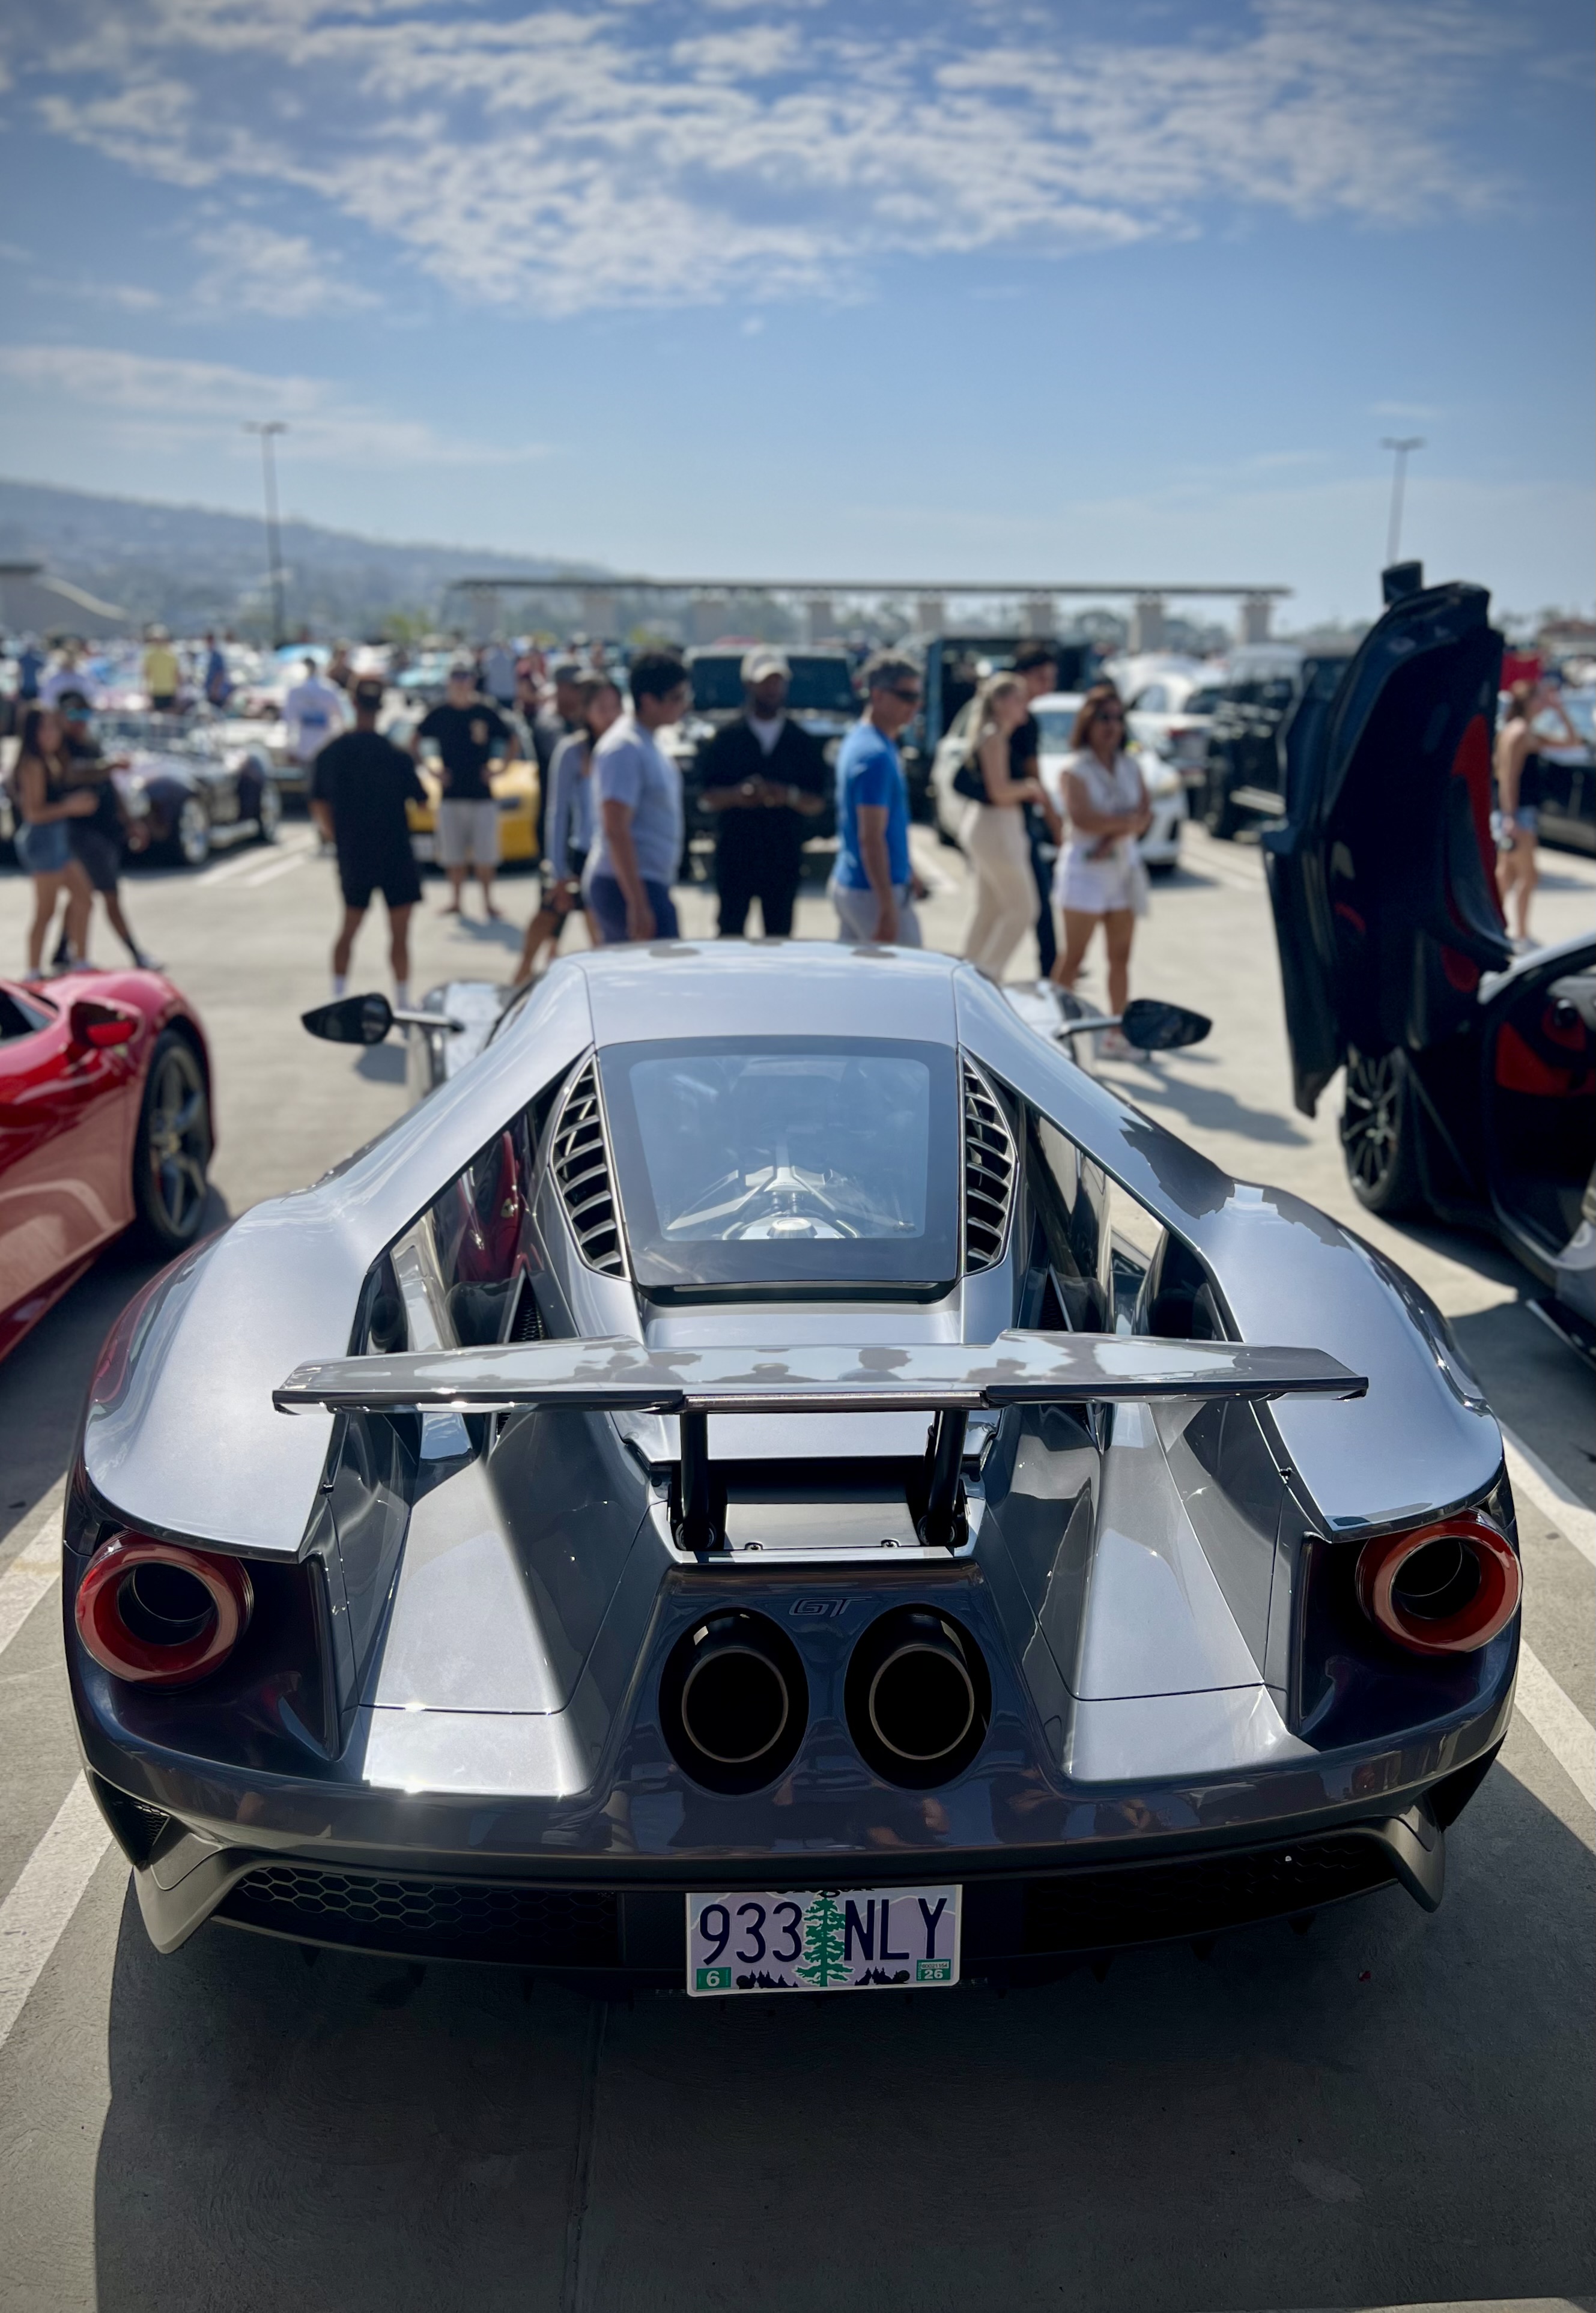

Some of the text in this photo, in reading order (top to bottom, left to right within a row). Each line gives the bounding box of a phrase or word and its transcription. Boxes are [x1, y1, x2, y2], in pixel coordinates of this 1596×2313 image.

[789, 1596, 872, 1617] GT
[700, 1897, 947, 1965] 933 NLY
[706, 1970, 720, 1987] 6
[924, 1969, 943, 1980] 26
